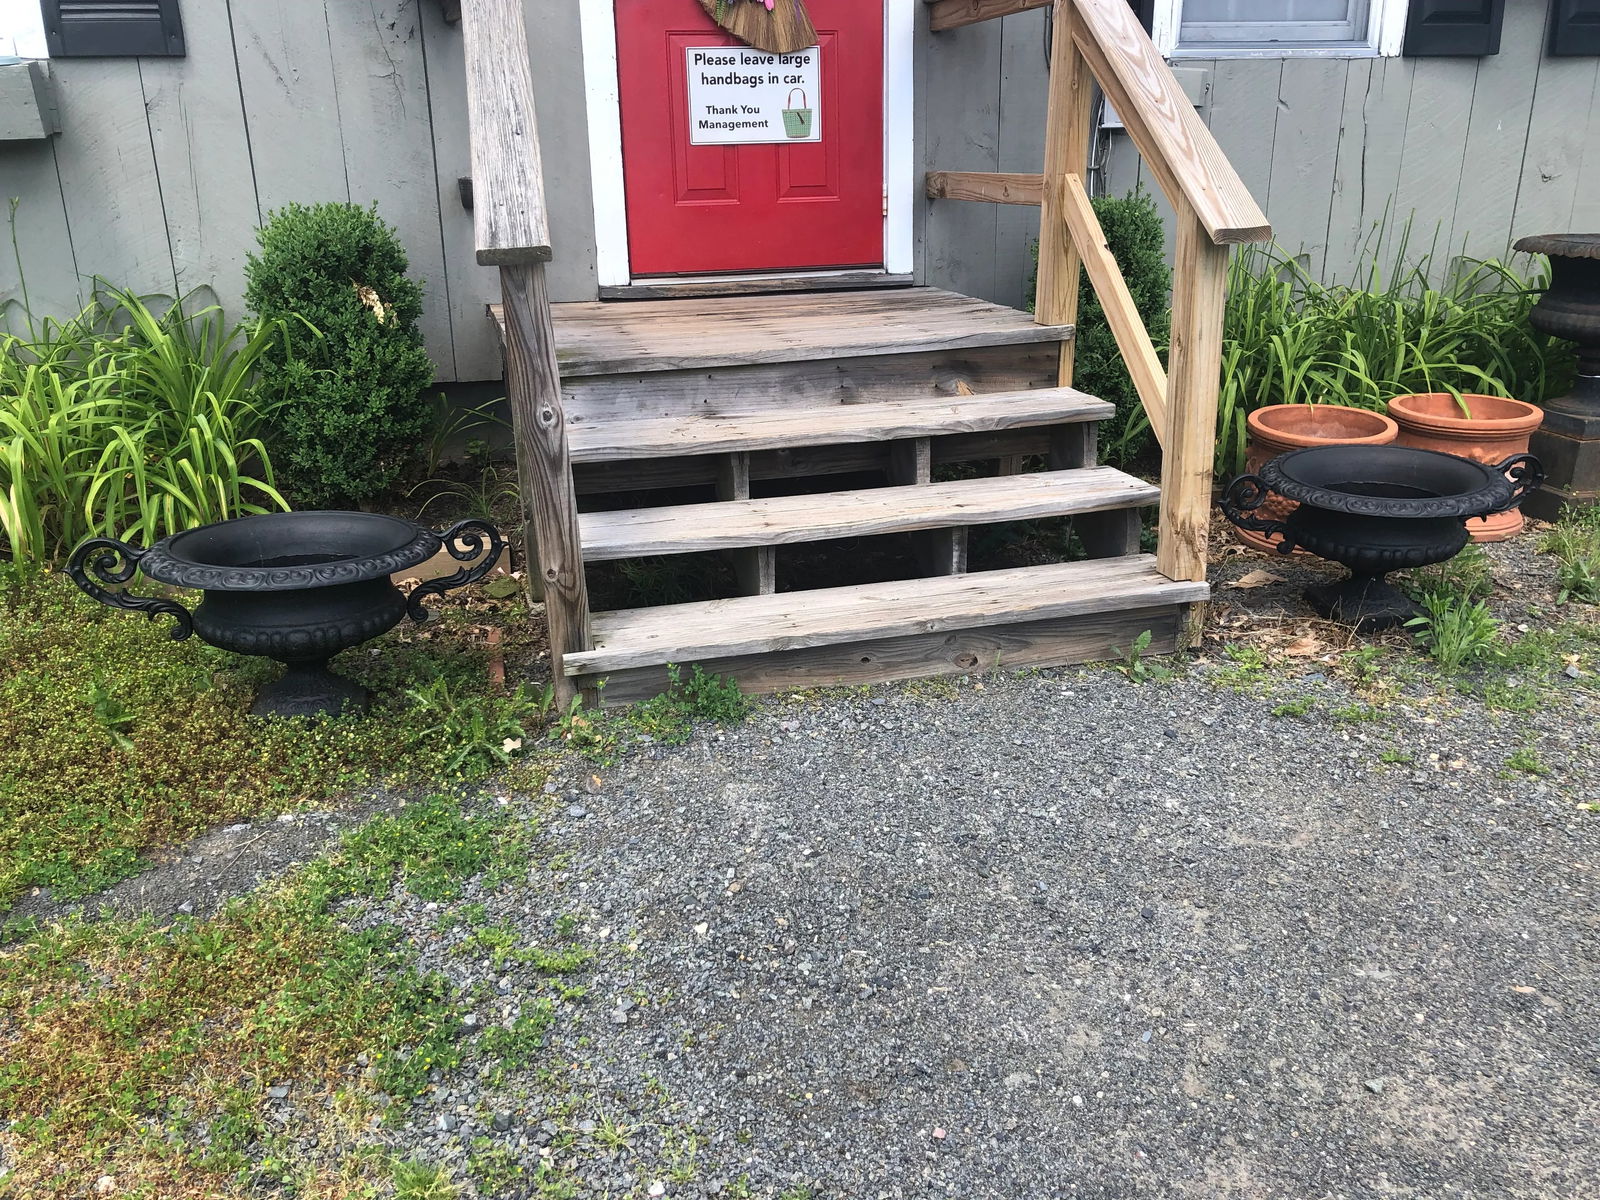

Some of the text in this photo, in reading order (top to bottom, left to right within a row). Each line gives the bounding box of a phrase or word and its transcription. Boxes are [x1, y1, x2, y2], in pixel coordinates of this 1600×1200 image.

[694, 52, 811, 68] Please leave large
[701, 72, 805, 88] handbags in car.
[705, 105, 760, 115] Thank You
[698, 119, 769, 131] Management
